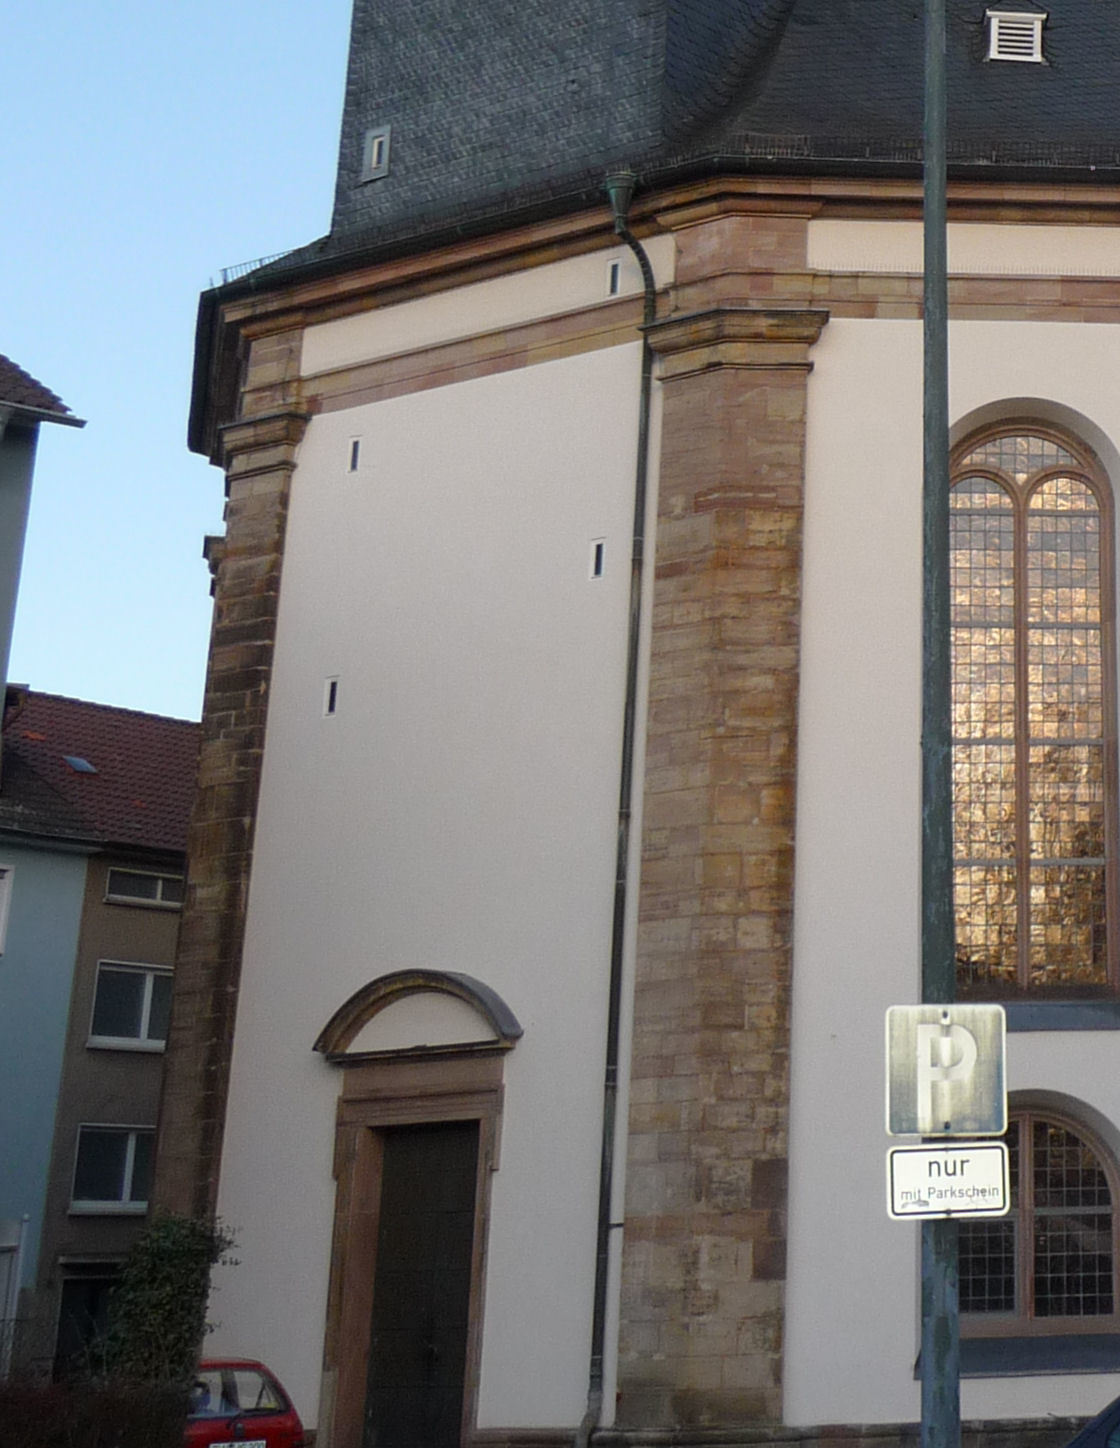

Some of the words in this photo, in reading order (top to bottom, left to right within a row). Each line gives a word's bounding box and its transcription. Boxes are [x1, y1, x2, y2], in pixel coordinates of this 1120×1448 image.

[917, 1023, 977, 1132] P
[928, 1158, 970, 1177] nur
[900, 1188, 923, 1201] mit
[927, 1185, 999, 1200] Parkschein
